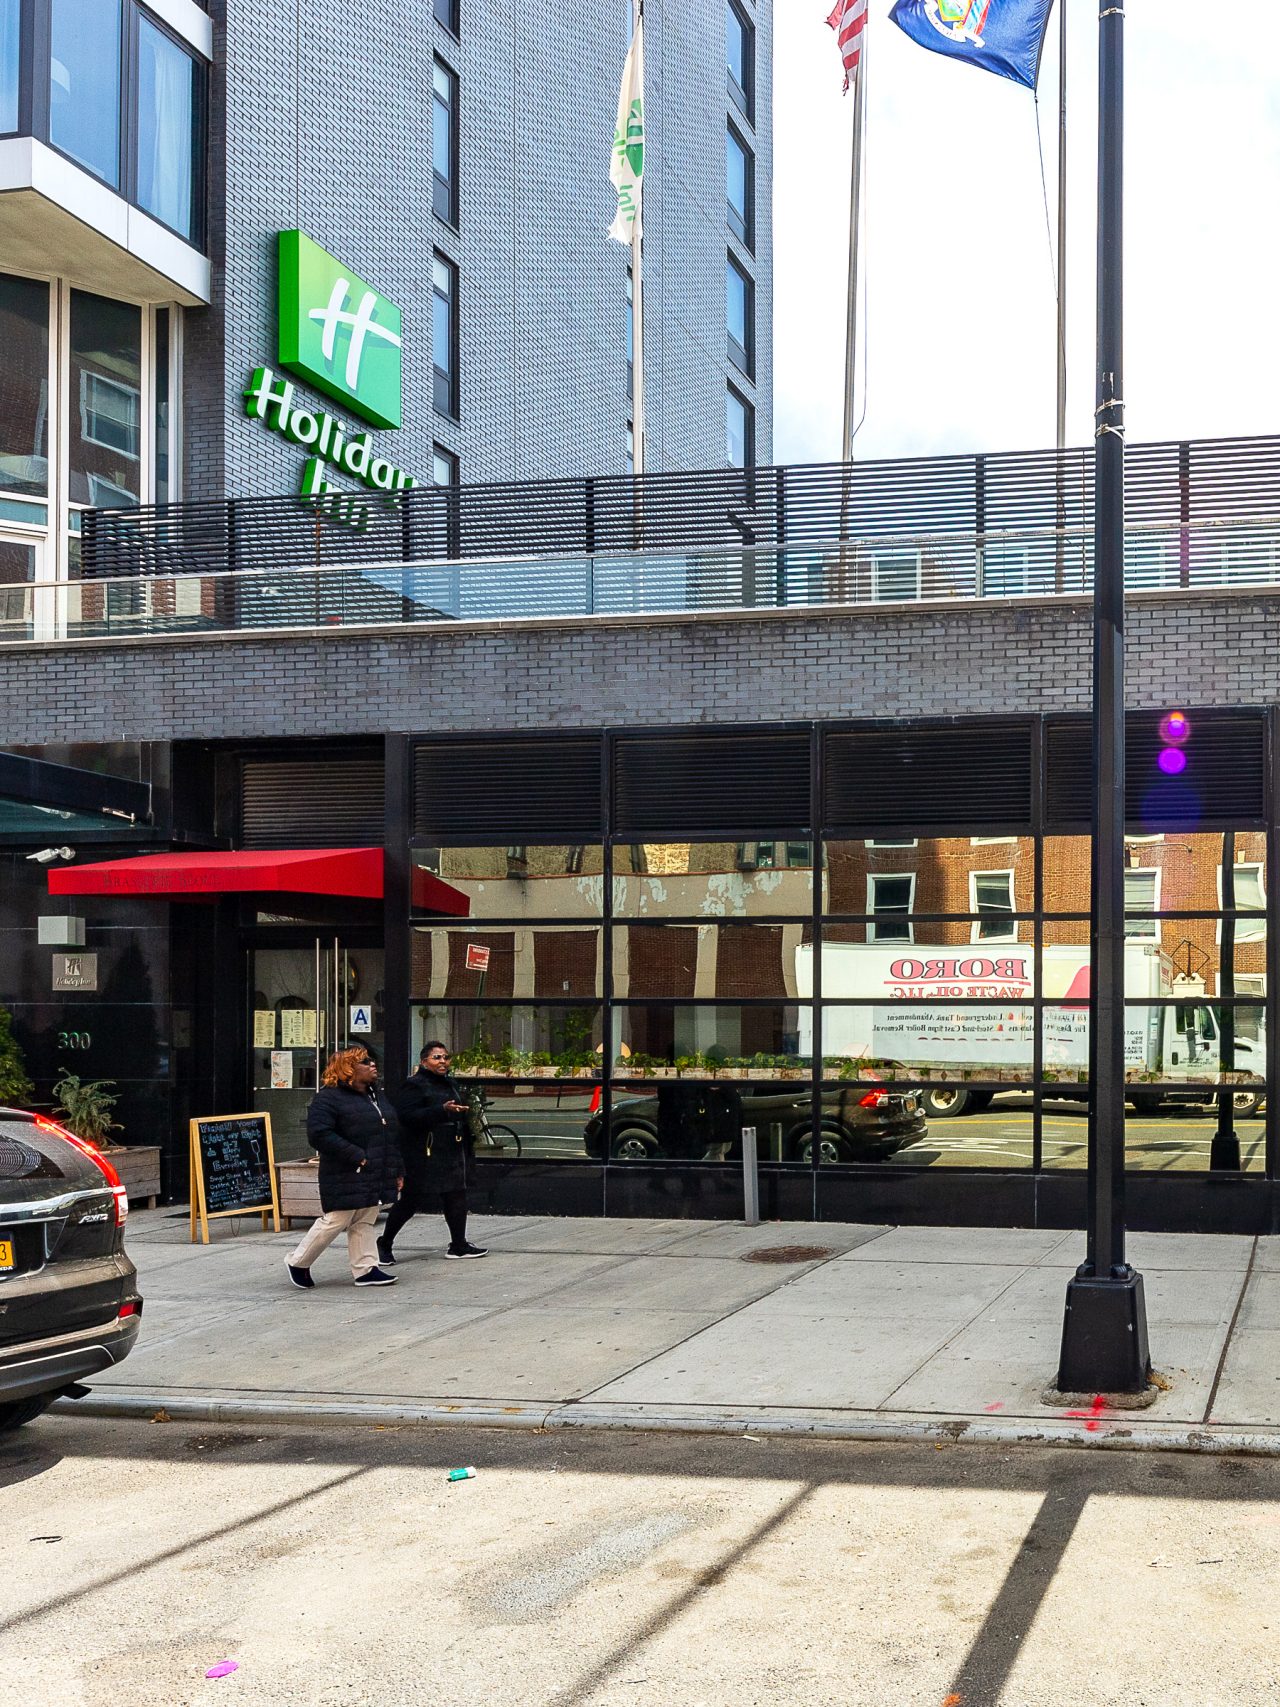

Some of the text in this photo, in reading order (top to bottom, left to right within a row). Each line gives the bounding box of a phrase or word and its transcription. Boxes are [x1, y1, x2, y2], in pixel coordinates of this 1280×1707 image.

[244, 367, 418, 507] Holiday
[353, 1008, 369, 1025] A
[57, 1032, 91, 1050] 300
[78, 1213, 109, 1225] AWD
